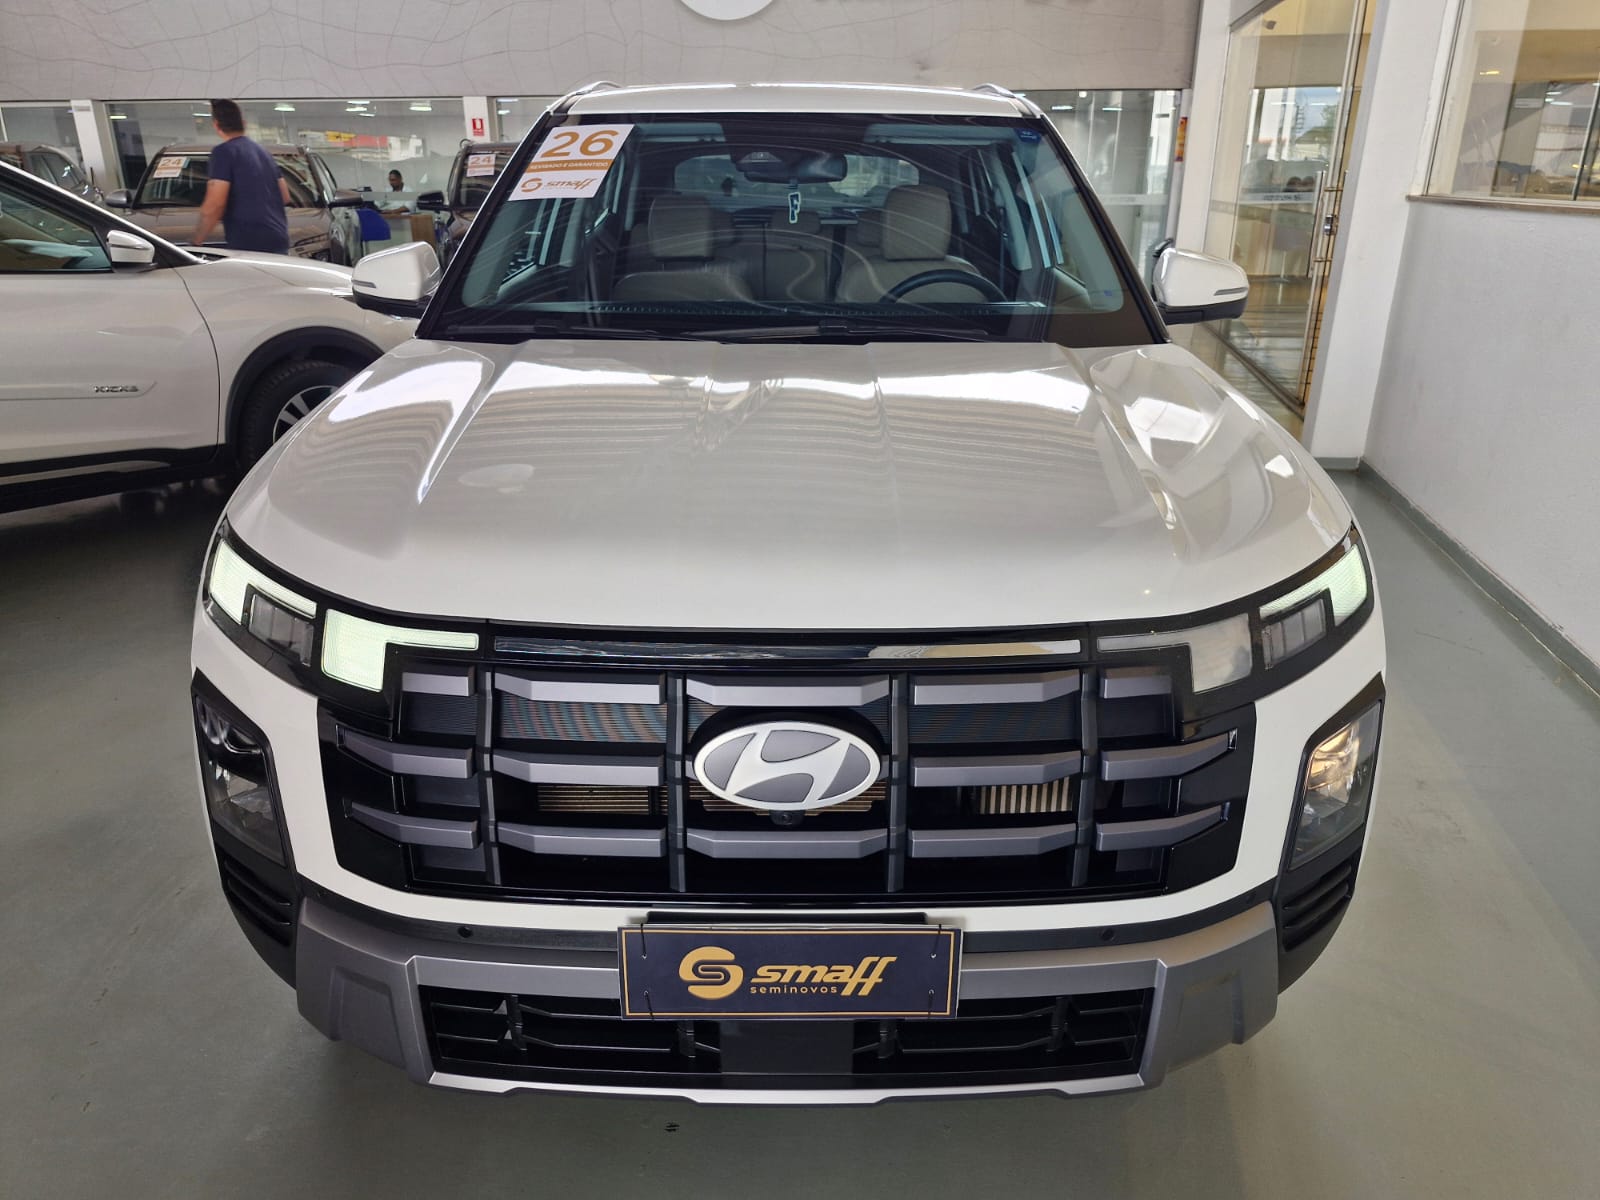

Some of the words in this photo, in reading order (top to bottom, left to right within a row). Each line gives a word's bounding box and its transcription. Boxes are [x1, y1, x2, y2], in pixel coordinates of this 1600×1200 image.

[541, 130, 619, 158] 26
[546, 178, 598, 190] smaff
[750, 956, 897, 996] smaff
[750, 985, 837, 995] seminovos
